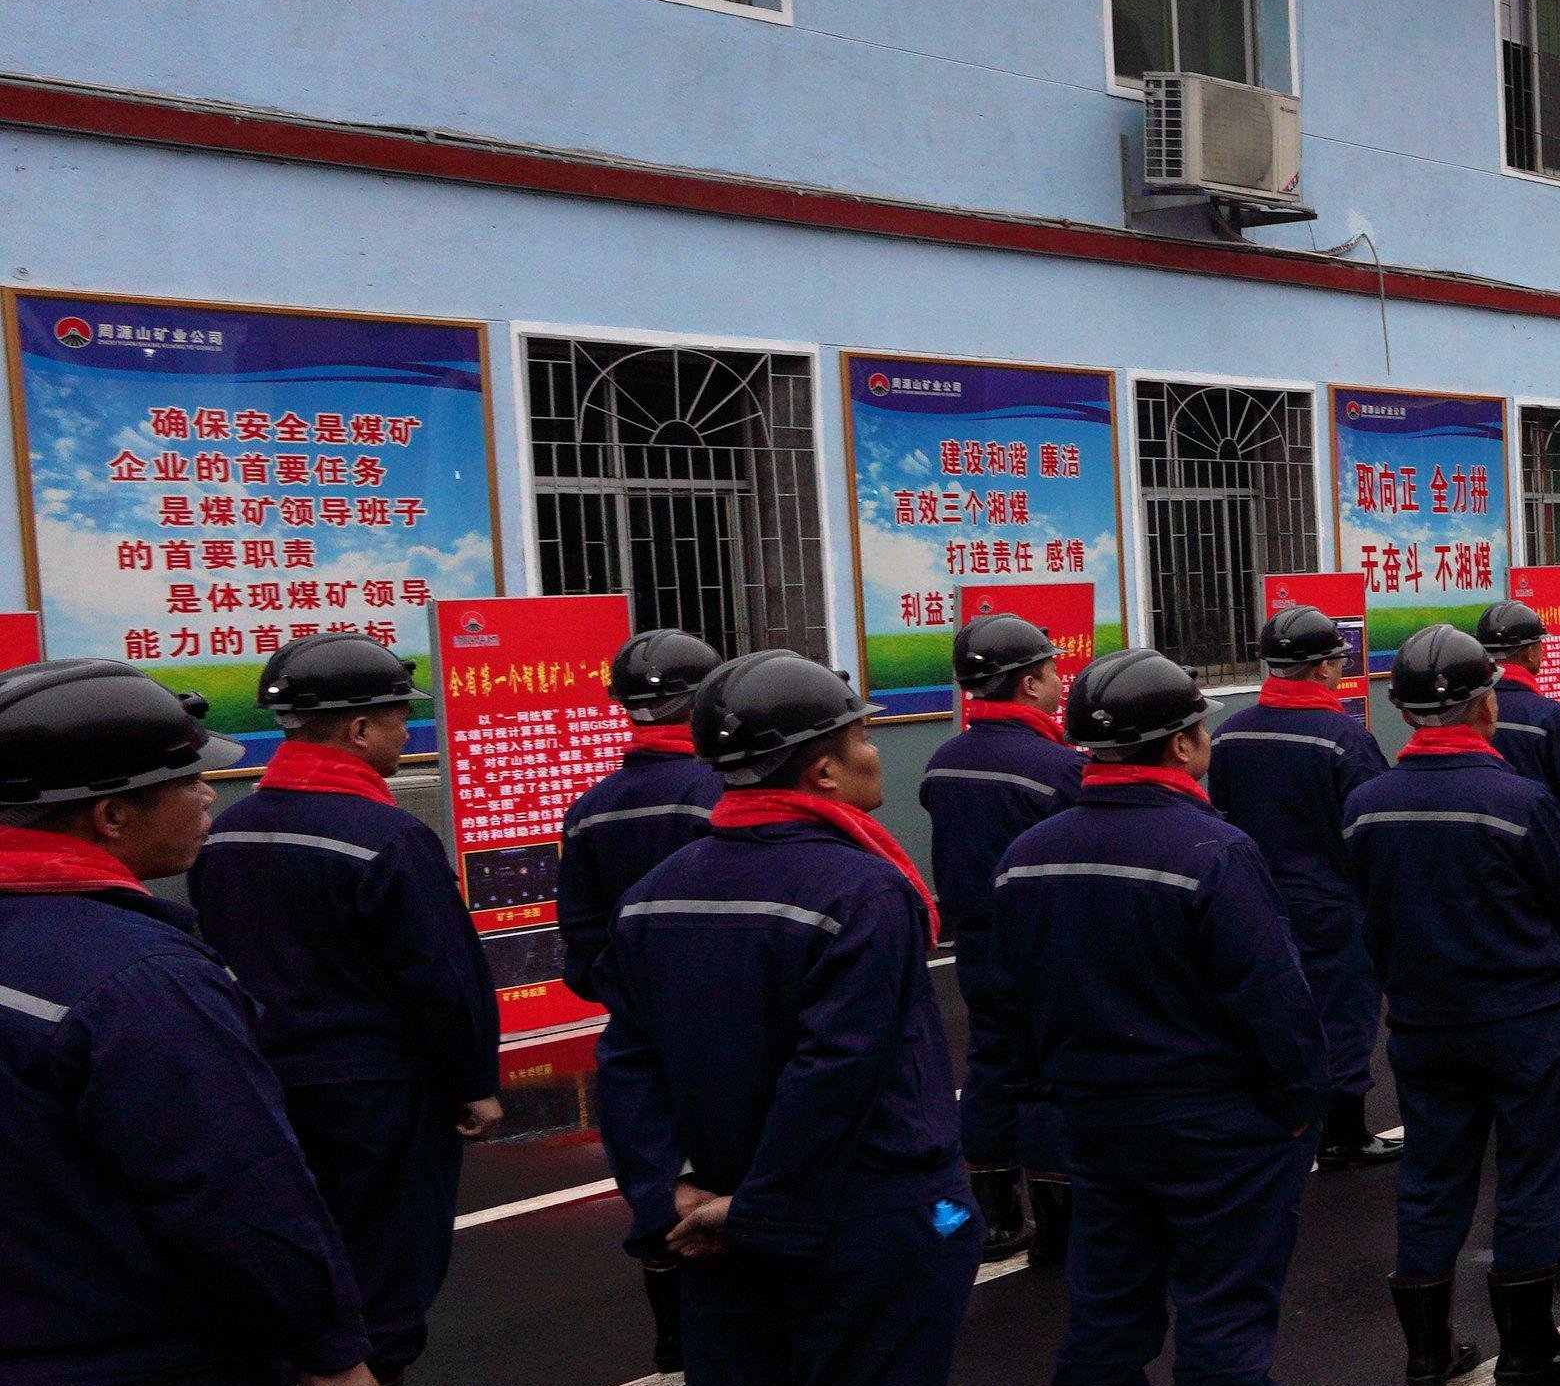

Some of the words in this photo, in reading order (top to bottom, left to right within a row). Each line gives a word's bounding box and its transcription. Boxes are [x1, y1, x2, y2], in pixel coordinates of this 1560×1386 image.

[98, 323, 224, 347] 周源山矿业公司
[150, 407, 421, 446] 确保安全是煤矿
[108, 450, 388, 487] 企业的首要任务
[939, 440, 1028, 477] 建设和谐
[1039, 444, 1080, 478] 廉洁
[1356, 463, 1419, 513] 取向正
[1429, 464, 1489, 514] 全力拼
[158, 495, 427, 528] 是煤矿领导班子
[894, 489, 1029, 525] 高效三个湘煤
[116, 539, 316, 570] 的首要职责
[946, 540, 1034, 575] 打造责任
[1046, 540, 1085, 573] 感情
[1360, 543, 1423, 593] 无奋斗
[1434, 542, 1493, 591] 不湘煤
[166, 579, 432, 614] 是体现煤矿领导
